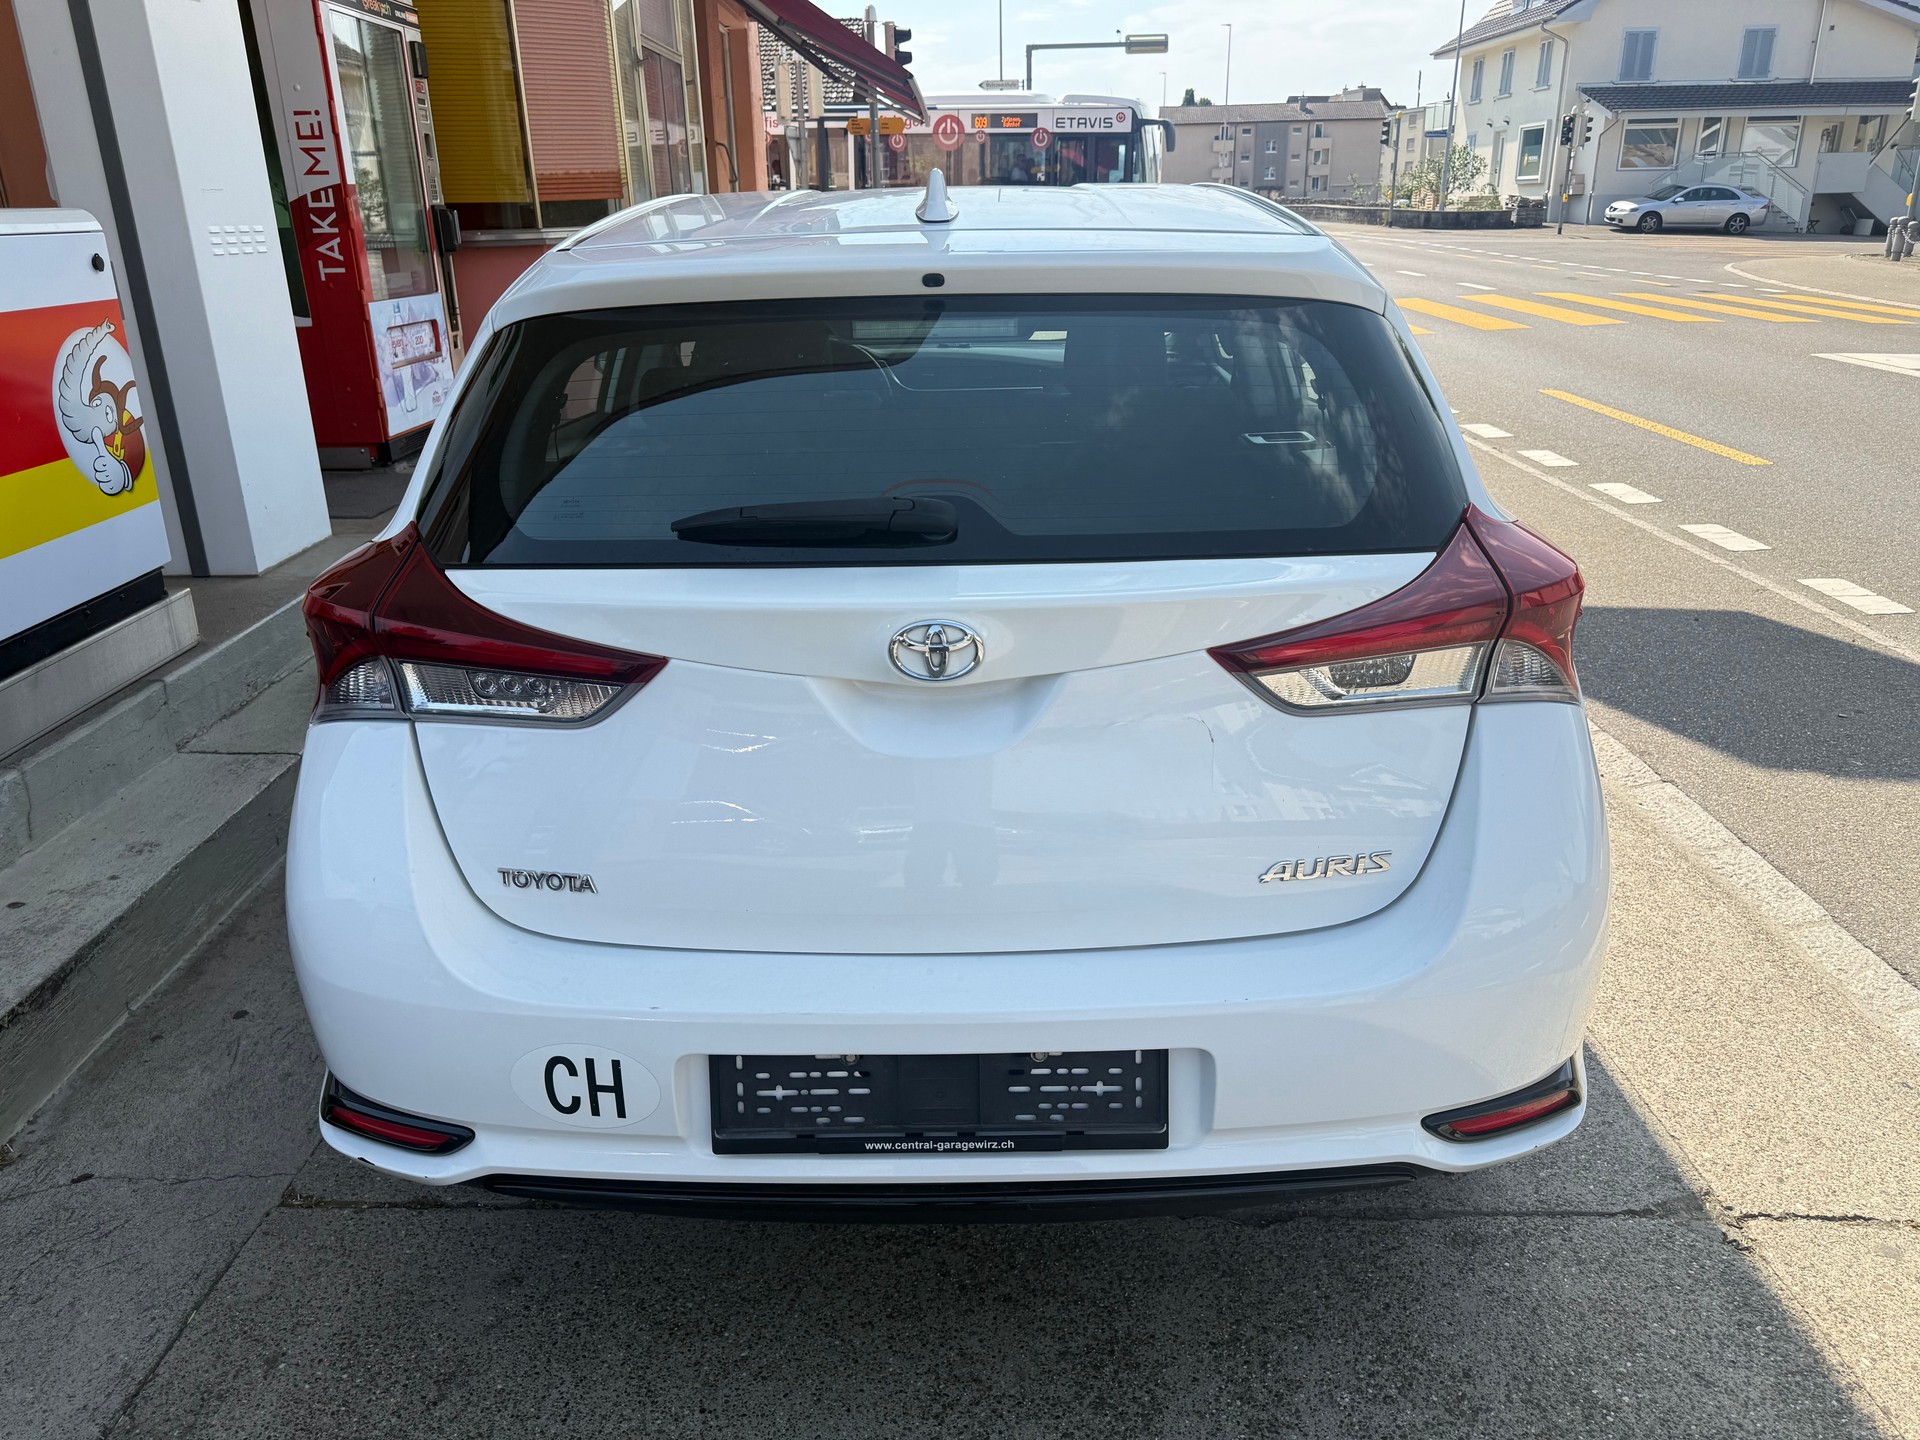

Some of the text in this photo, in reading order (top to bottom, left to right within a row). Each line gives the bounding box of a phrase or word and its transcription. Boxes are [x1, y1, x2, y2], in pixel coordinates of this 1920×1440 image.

[1055, 116, 1114, 129] ETAVIS
[293, 109, 346, 281] TAKE ME!
[497, 867, 599, 894] TOYOTA
[1258, 850, 1393, 883] AURIS
[544, 1055, 627, 1119] CH
[864, 1139, 1015, 1151] www.central-garagewirz.ch
